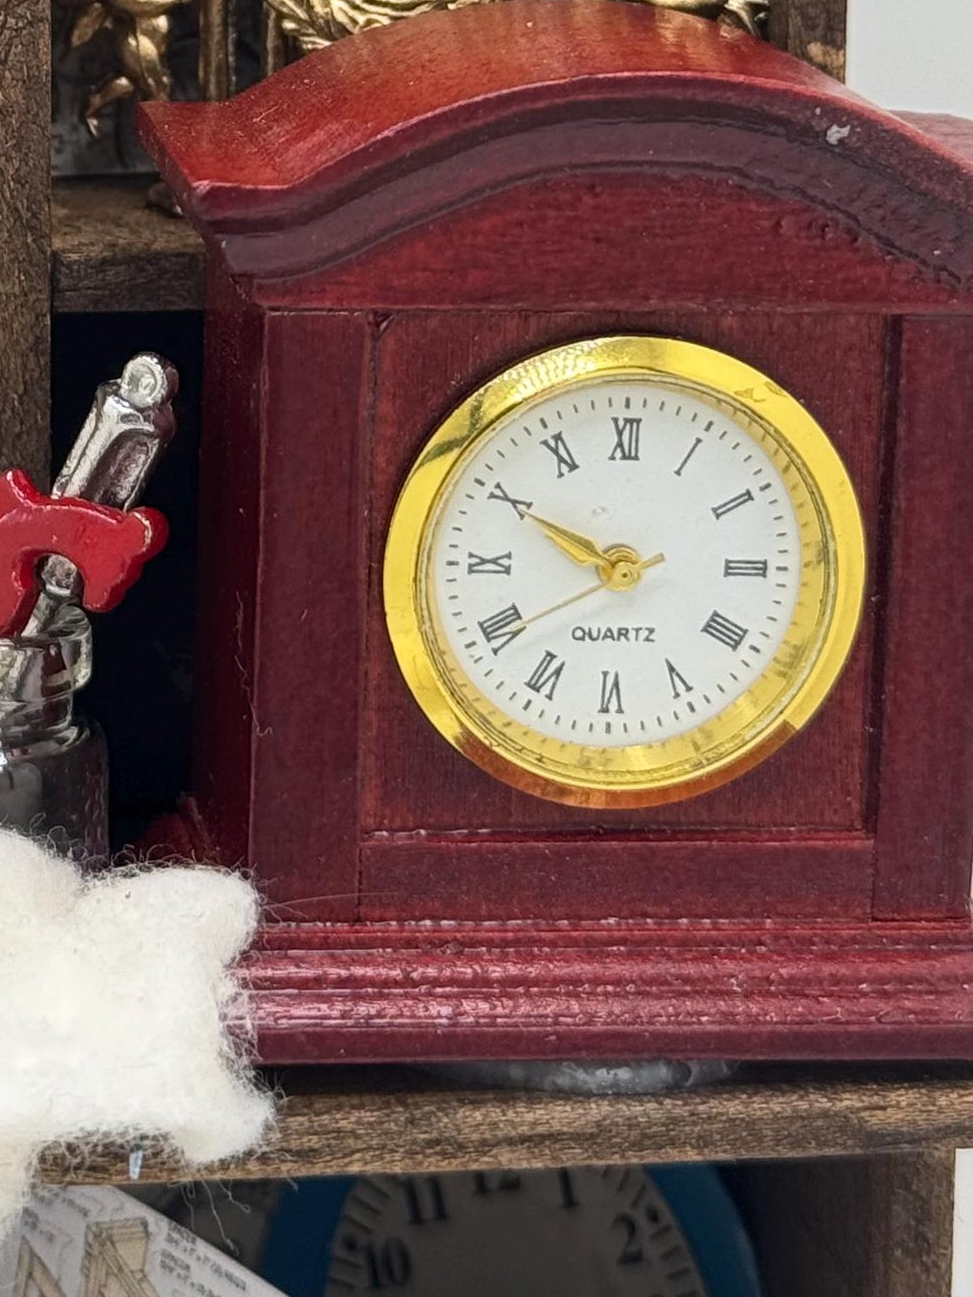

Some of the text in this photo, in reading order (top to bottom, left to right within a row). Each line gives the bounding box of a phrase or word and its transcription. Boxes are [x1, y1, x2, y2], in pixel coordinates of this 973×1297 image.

[609, 417, 642, 461] XII
[541, 431, 580, 479] XI
[487, 482, 533, 520] X
[467, 550, 512, 575] IX
[724, 558, 768, 578] III
[571, 626, 656, 643] QUARTZ
